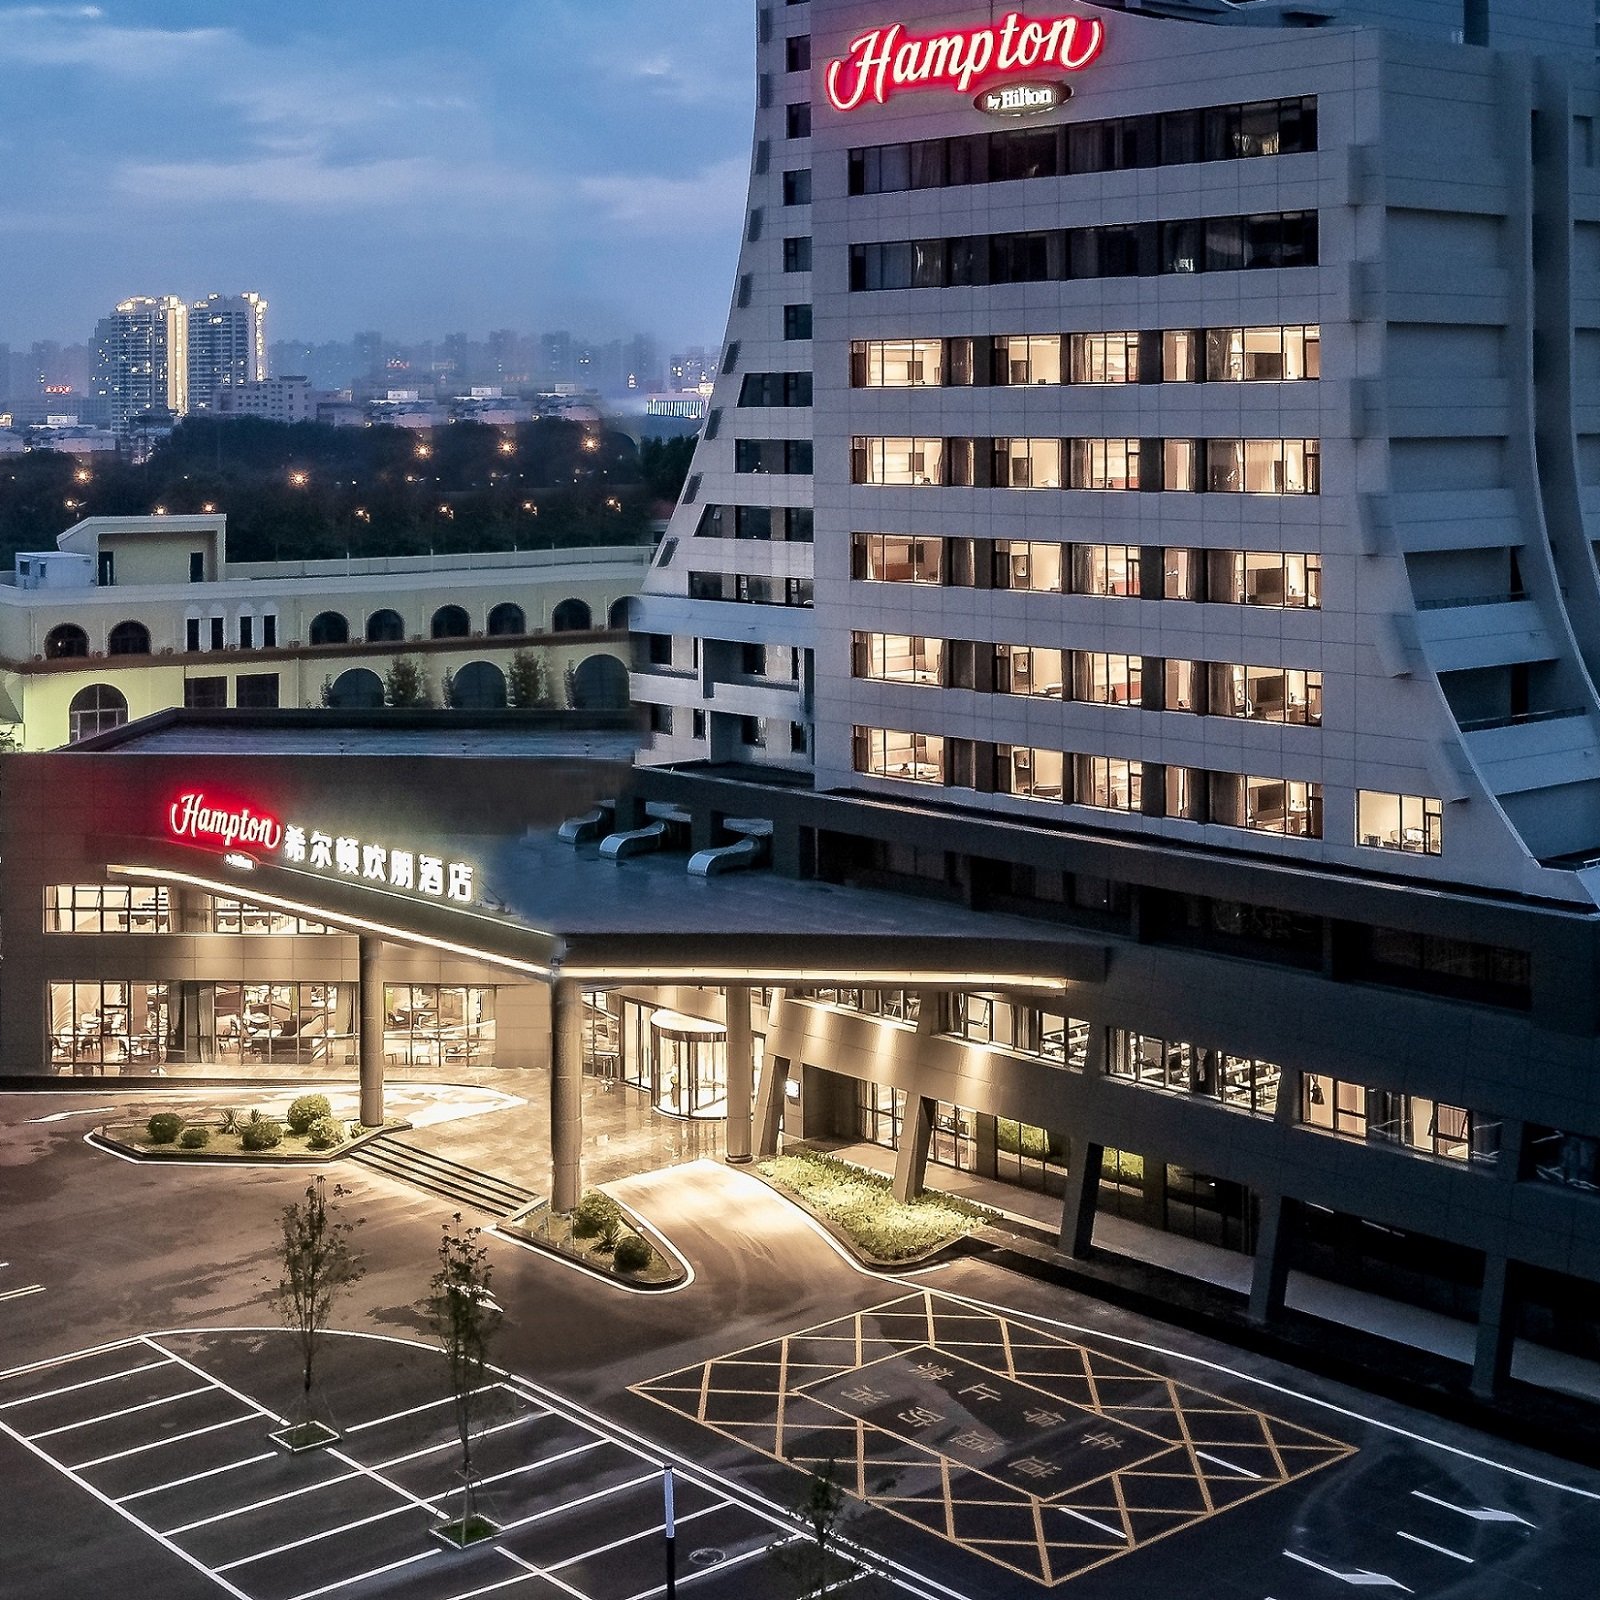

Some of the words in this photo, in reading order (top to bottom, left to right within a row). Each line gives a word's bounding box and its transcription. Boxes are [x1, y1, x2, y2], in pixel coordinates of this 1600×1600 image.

[827, 12, 1102, 111] Hampton
[1001, 87, 1052, 108] Hilton
[171, 793, 281, 848] Hampton
[283, 824, 474, 902] 希尔顿欢朋酒店
